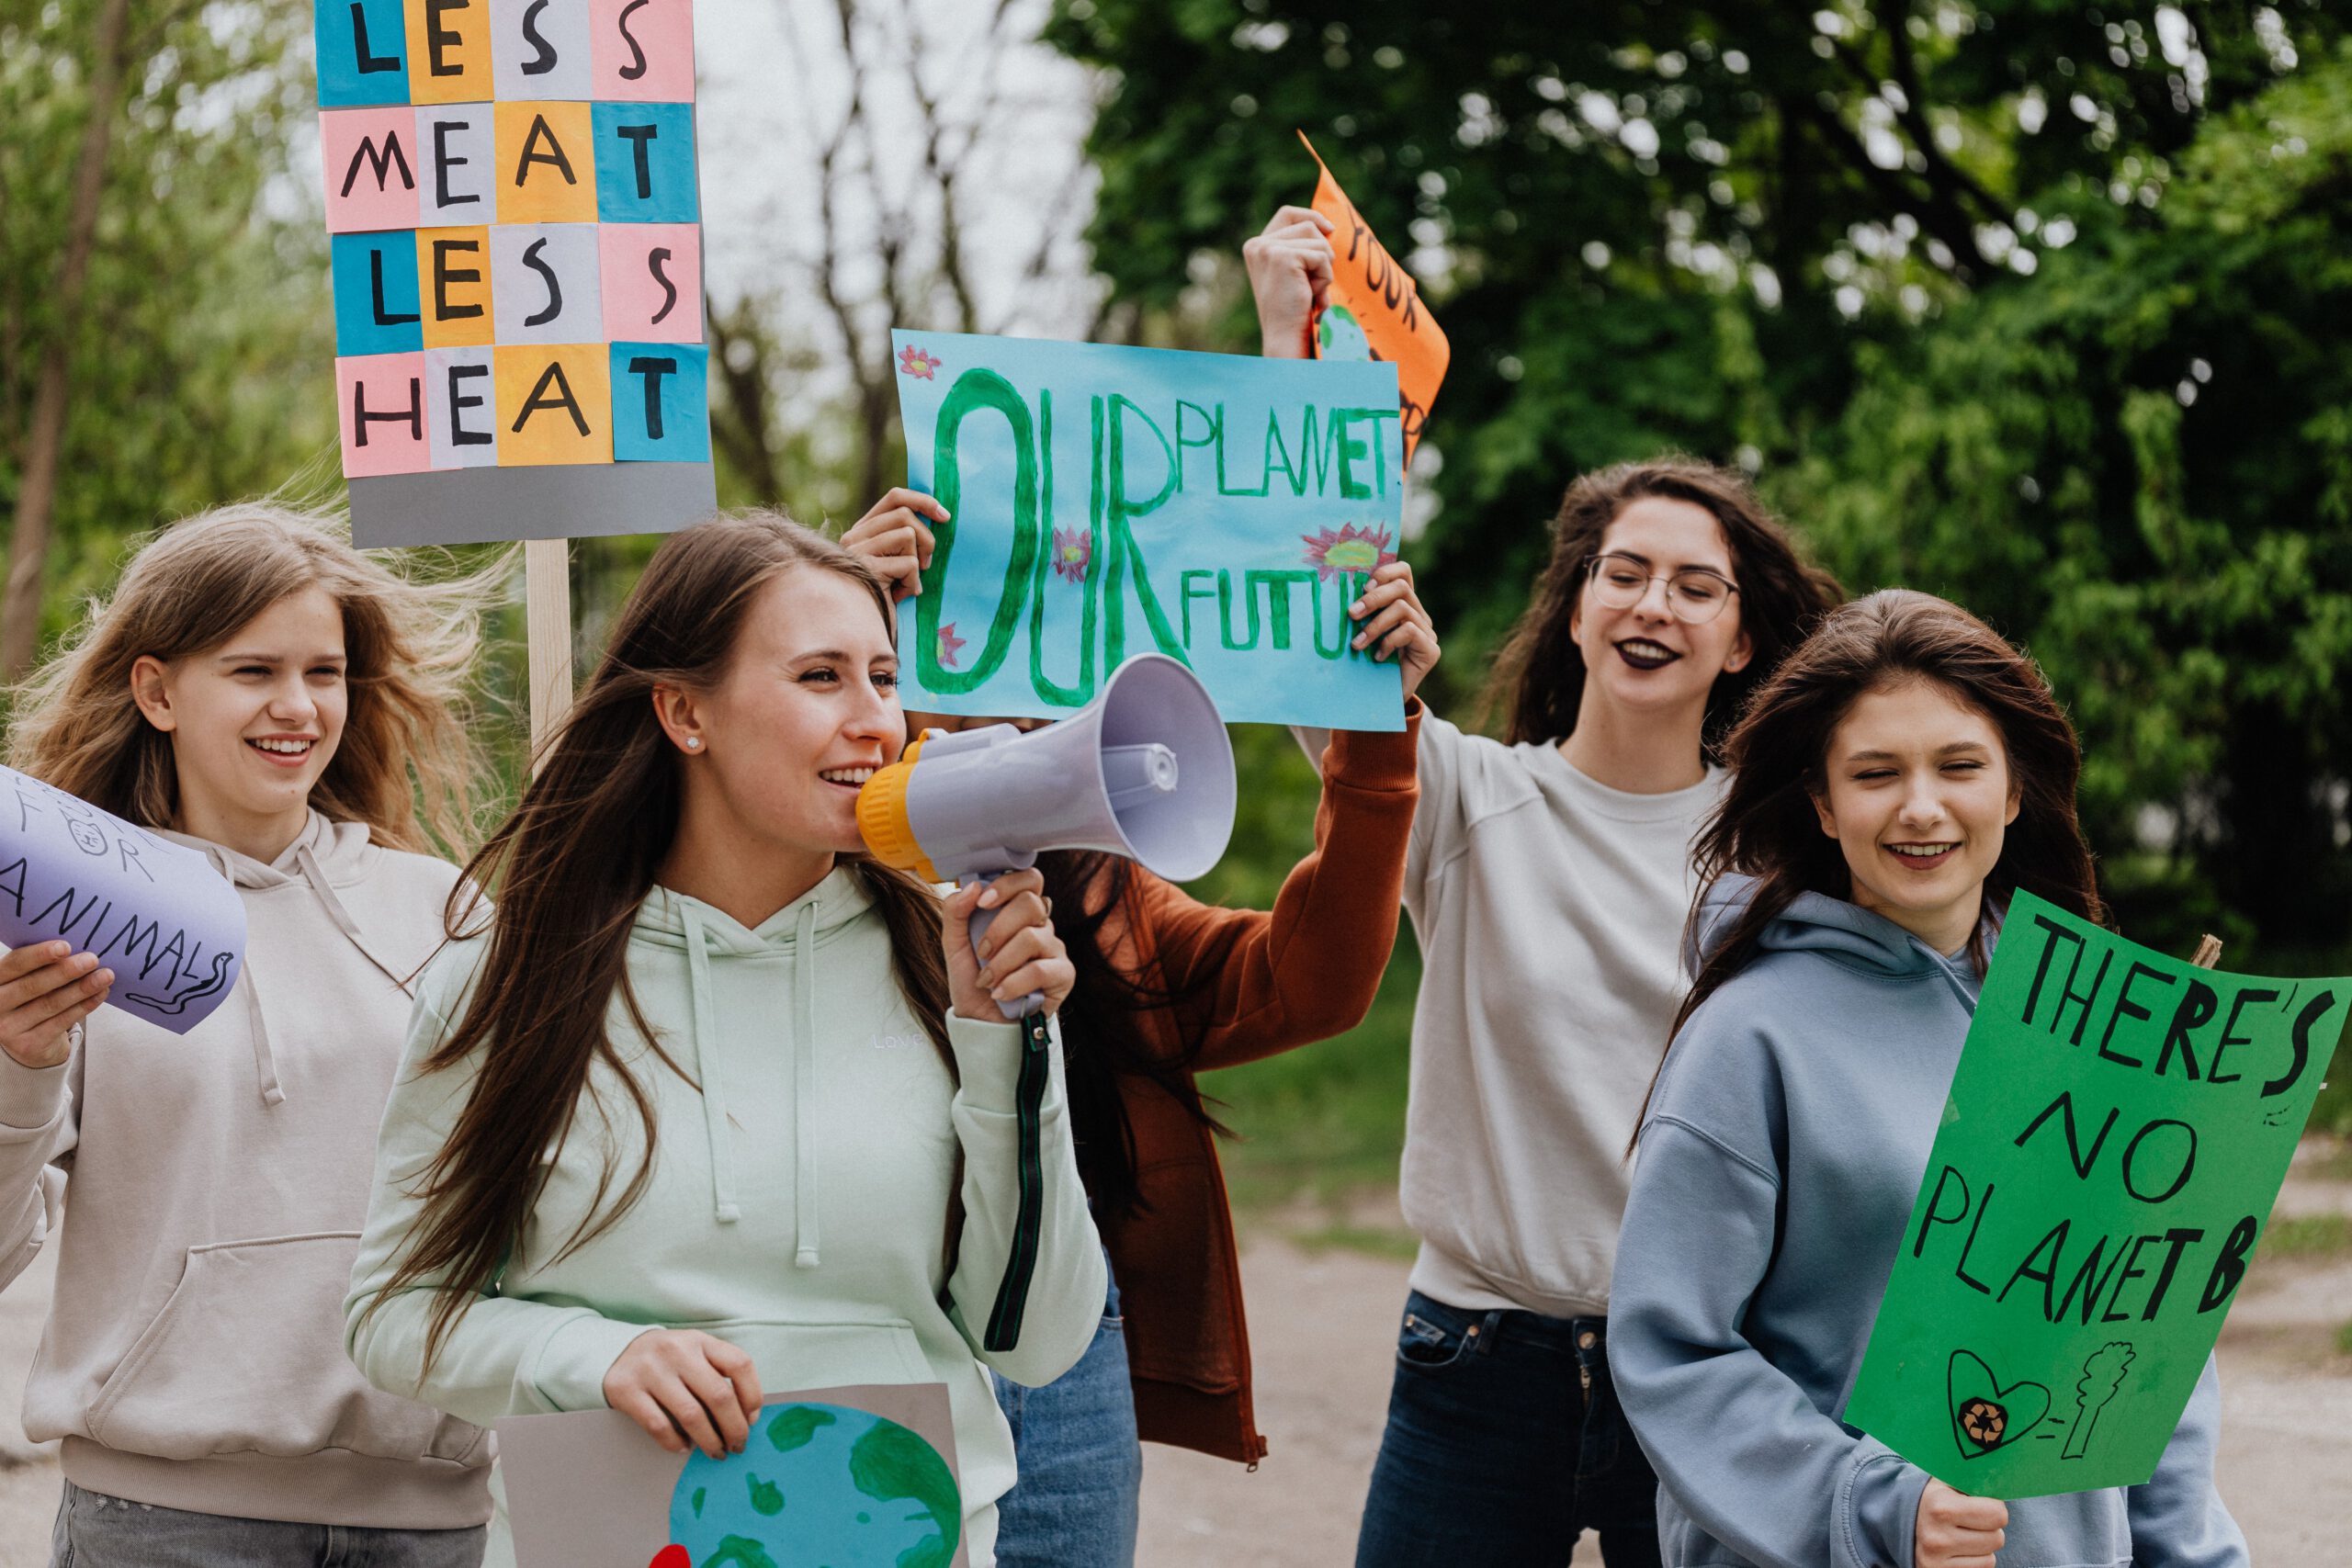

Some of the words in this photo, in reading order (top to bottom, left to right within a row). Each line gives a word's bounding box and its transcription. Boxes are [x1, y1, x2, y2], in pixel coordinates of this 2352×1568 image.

[350, 0, 648, 81] LESS
[341, 114, 658, 209] MEAT
[369, 237, 677, 327] LESS
[355, 356, 677, 446] HEAT
[1177, 398, 1400, 500] PLANET
[915, 367, 1195, 707] OUR
[1182, 568, 1400, 664] FUTU
[2021, 913, 2336, 1099] THERE'S
[2014, 1090, 2198, 1203] NO
[1913, 1165, 2205, 1325] PLANET
[2198, 1215, 2257, 1315] B
